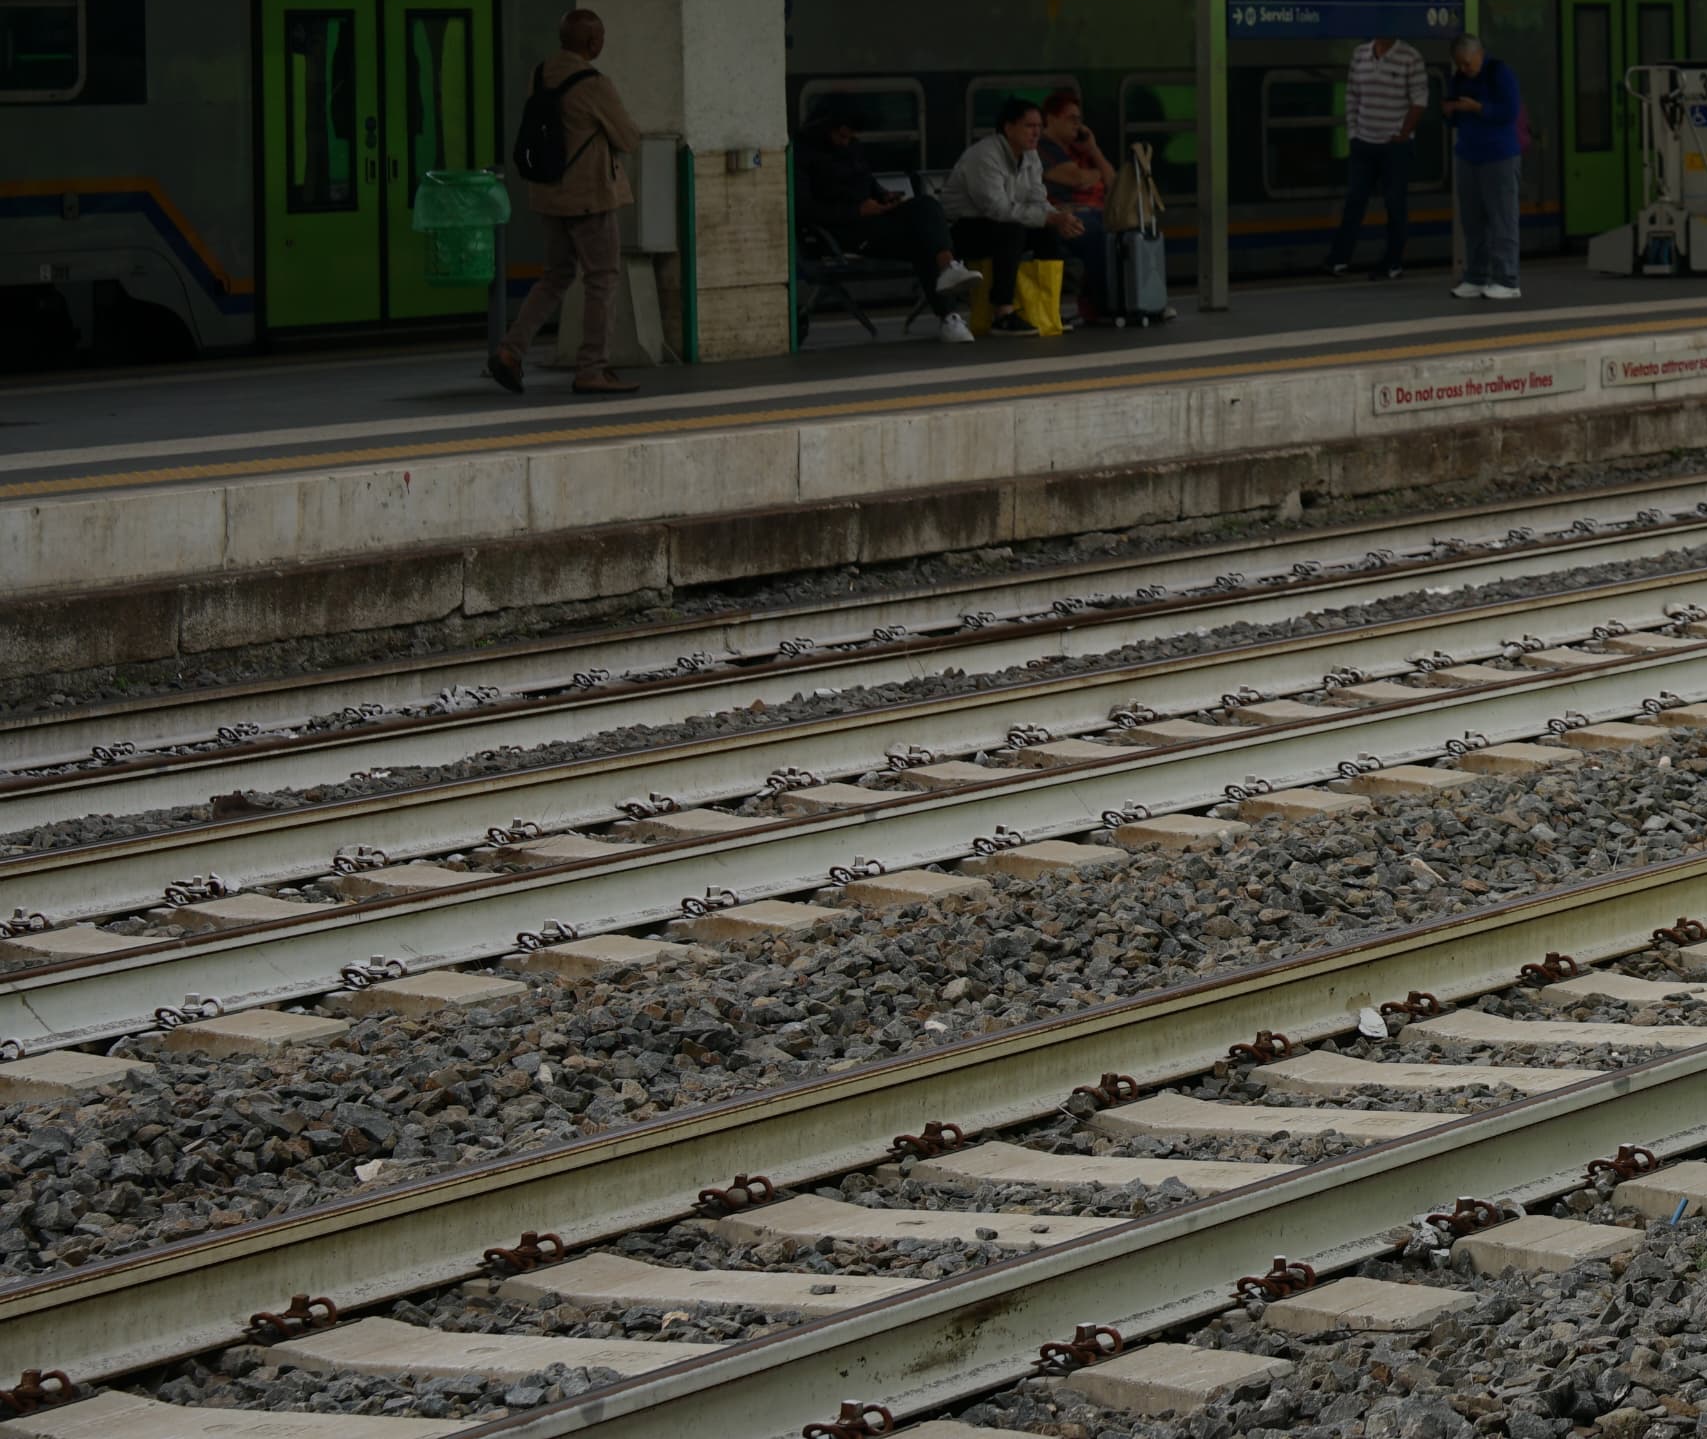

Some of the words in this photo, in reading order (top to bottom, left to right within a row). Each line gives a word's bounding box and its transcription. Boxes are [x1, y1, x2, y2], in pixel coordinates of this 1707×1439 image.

[1259, 6, 1294, 24] Servizi
[1622, 362, 1659, 378] Vietato
[1396, 387, 1412, 404] Do
[1416, 387, 1433, 402] not
[1436, 387, 1464, 399] cross
[1466, 378, 1483, 395] the
[1485, 375, 1527, 394] railway
[1529, 371, 1553, 389] lines
